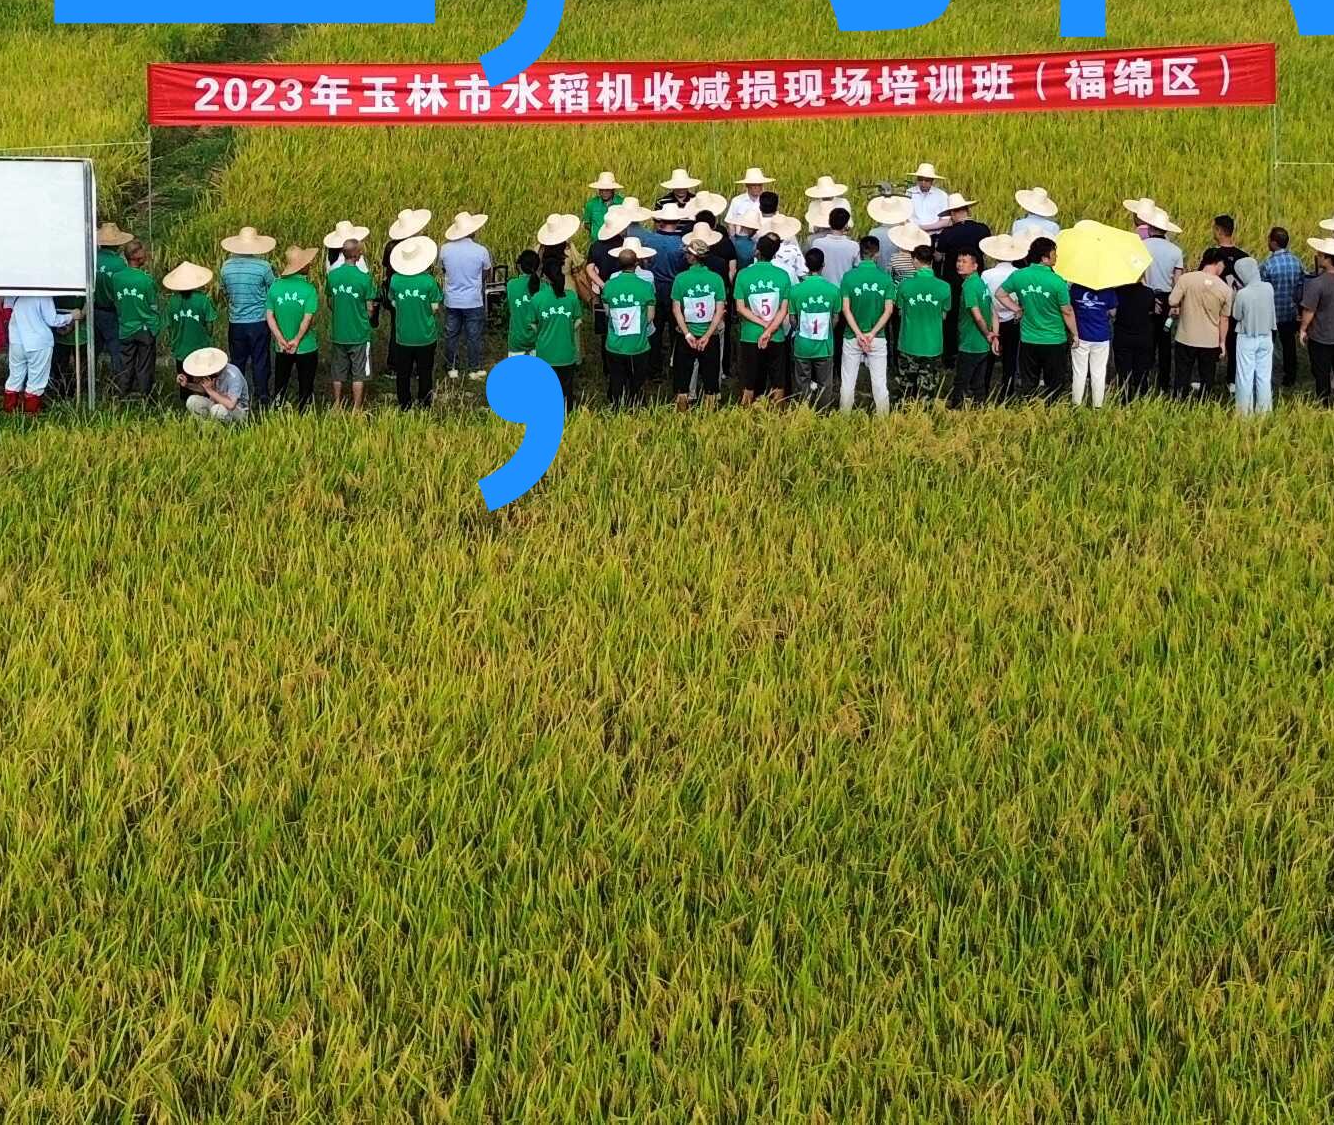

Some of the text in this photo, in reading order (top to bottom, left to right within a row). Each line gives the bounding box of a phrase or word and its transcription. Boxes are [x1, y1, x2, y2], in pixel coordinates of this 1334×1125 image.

[695, 302, 706, 319] 3
[761, 298, 771, 317] 5
[619, 313, 630, 331] 2
[811, 319, 818, 335] 1
